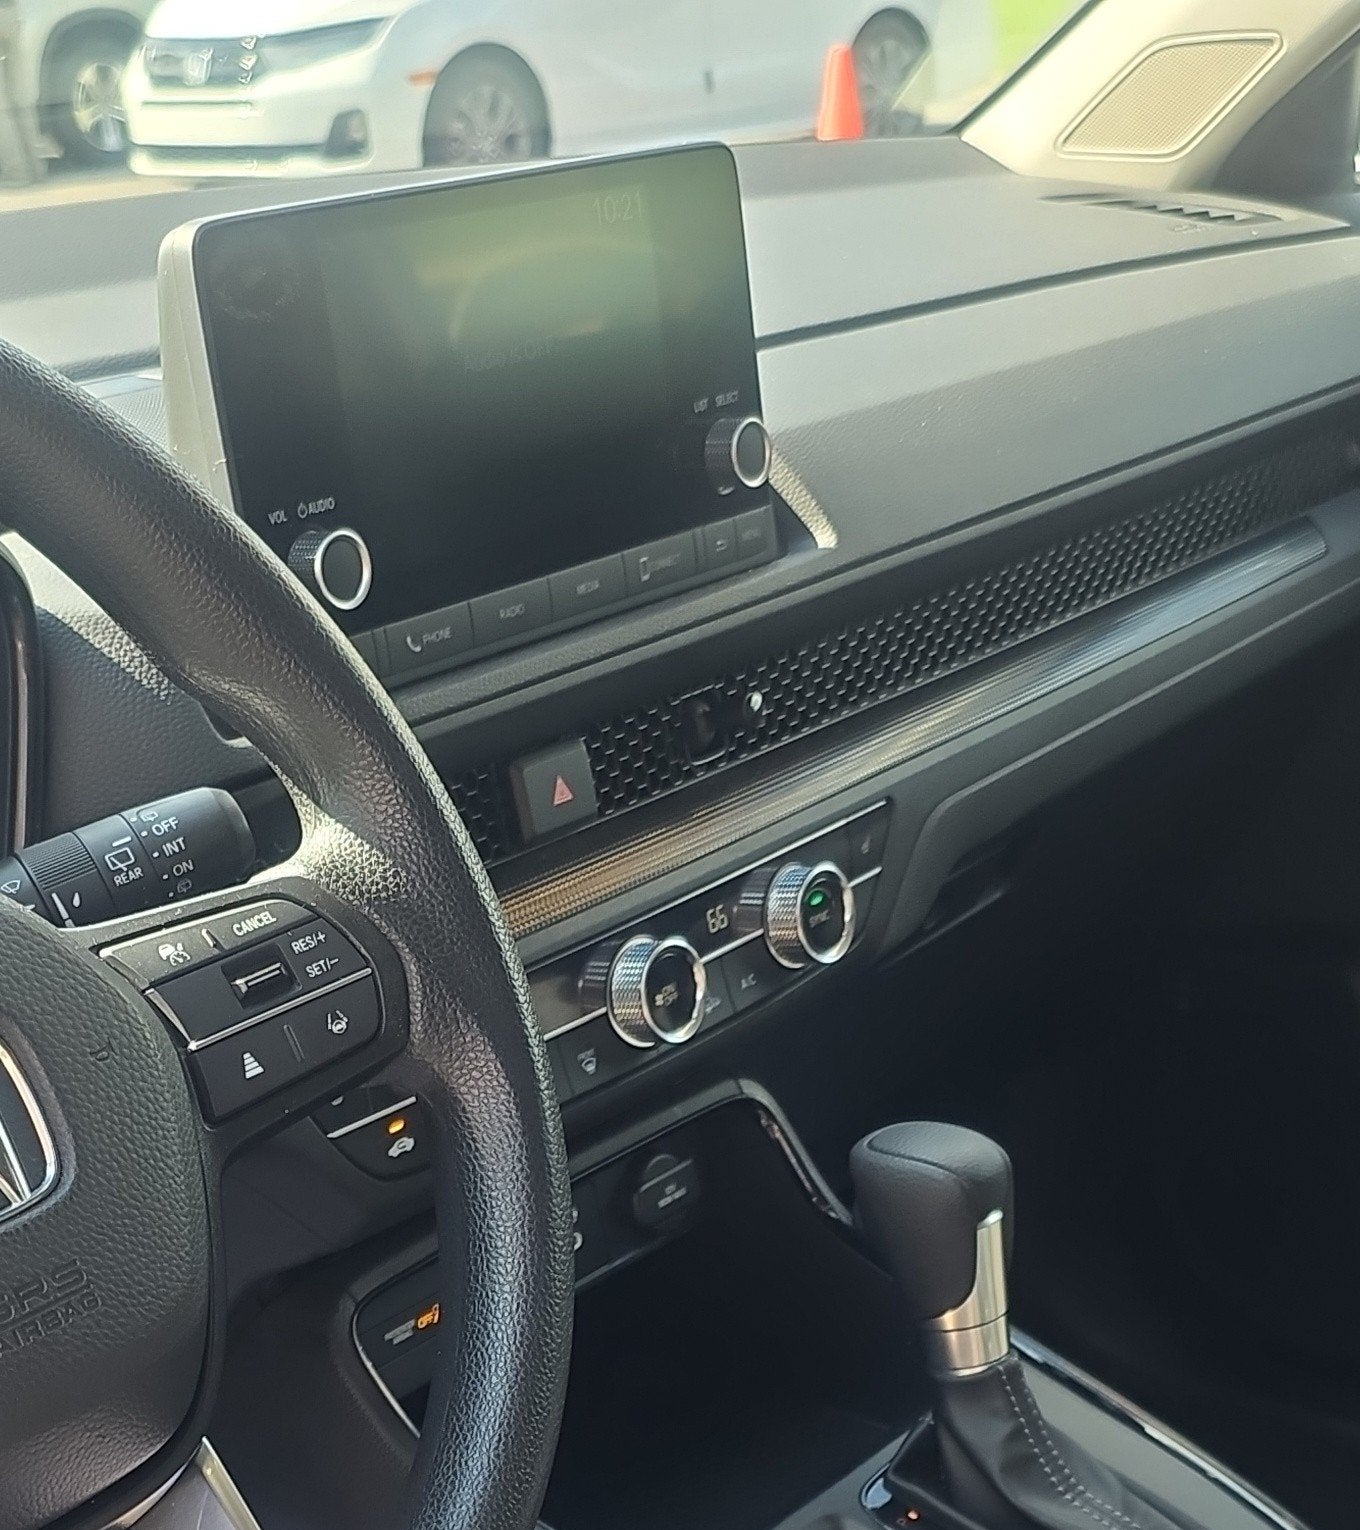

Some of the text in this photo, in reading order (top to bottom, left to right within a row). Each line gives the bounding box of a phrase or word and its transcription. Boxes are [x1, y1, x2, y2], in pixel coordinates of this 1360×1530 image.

[268, 497, 335, 525] VOL AUDIO
[151, 816, 180, 837] OFF
[161, 836, 188, 858] INT
[113, 867, 144, 887] REAR
[172, 860, 195, 878] ON
[232, 911, 277, 938] CANCEL
[291, 931, 326, 955] RES/+
